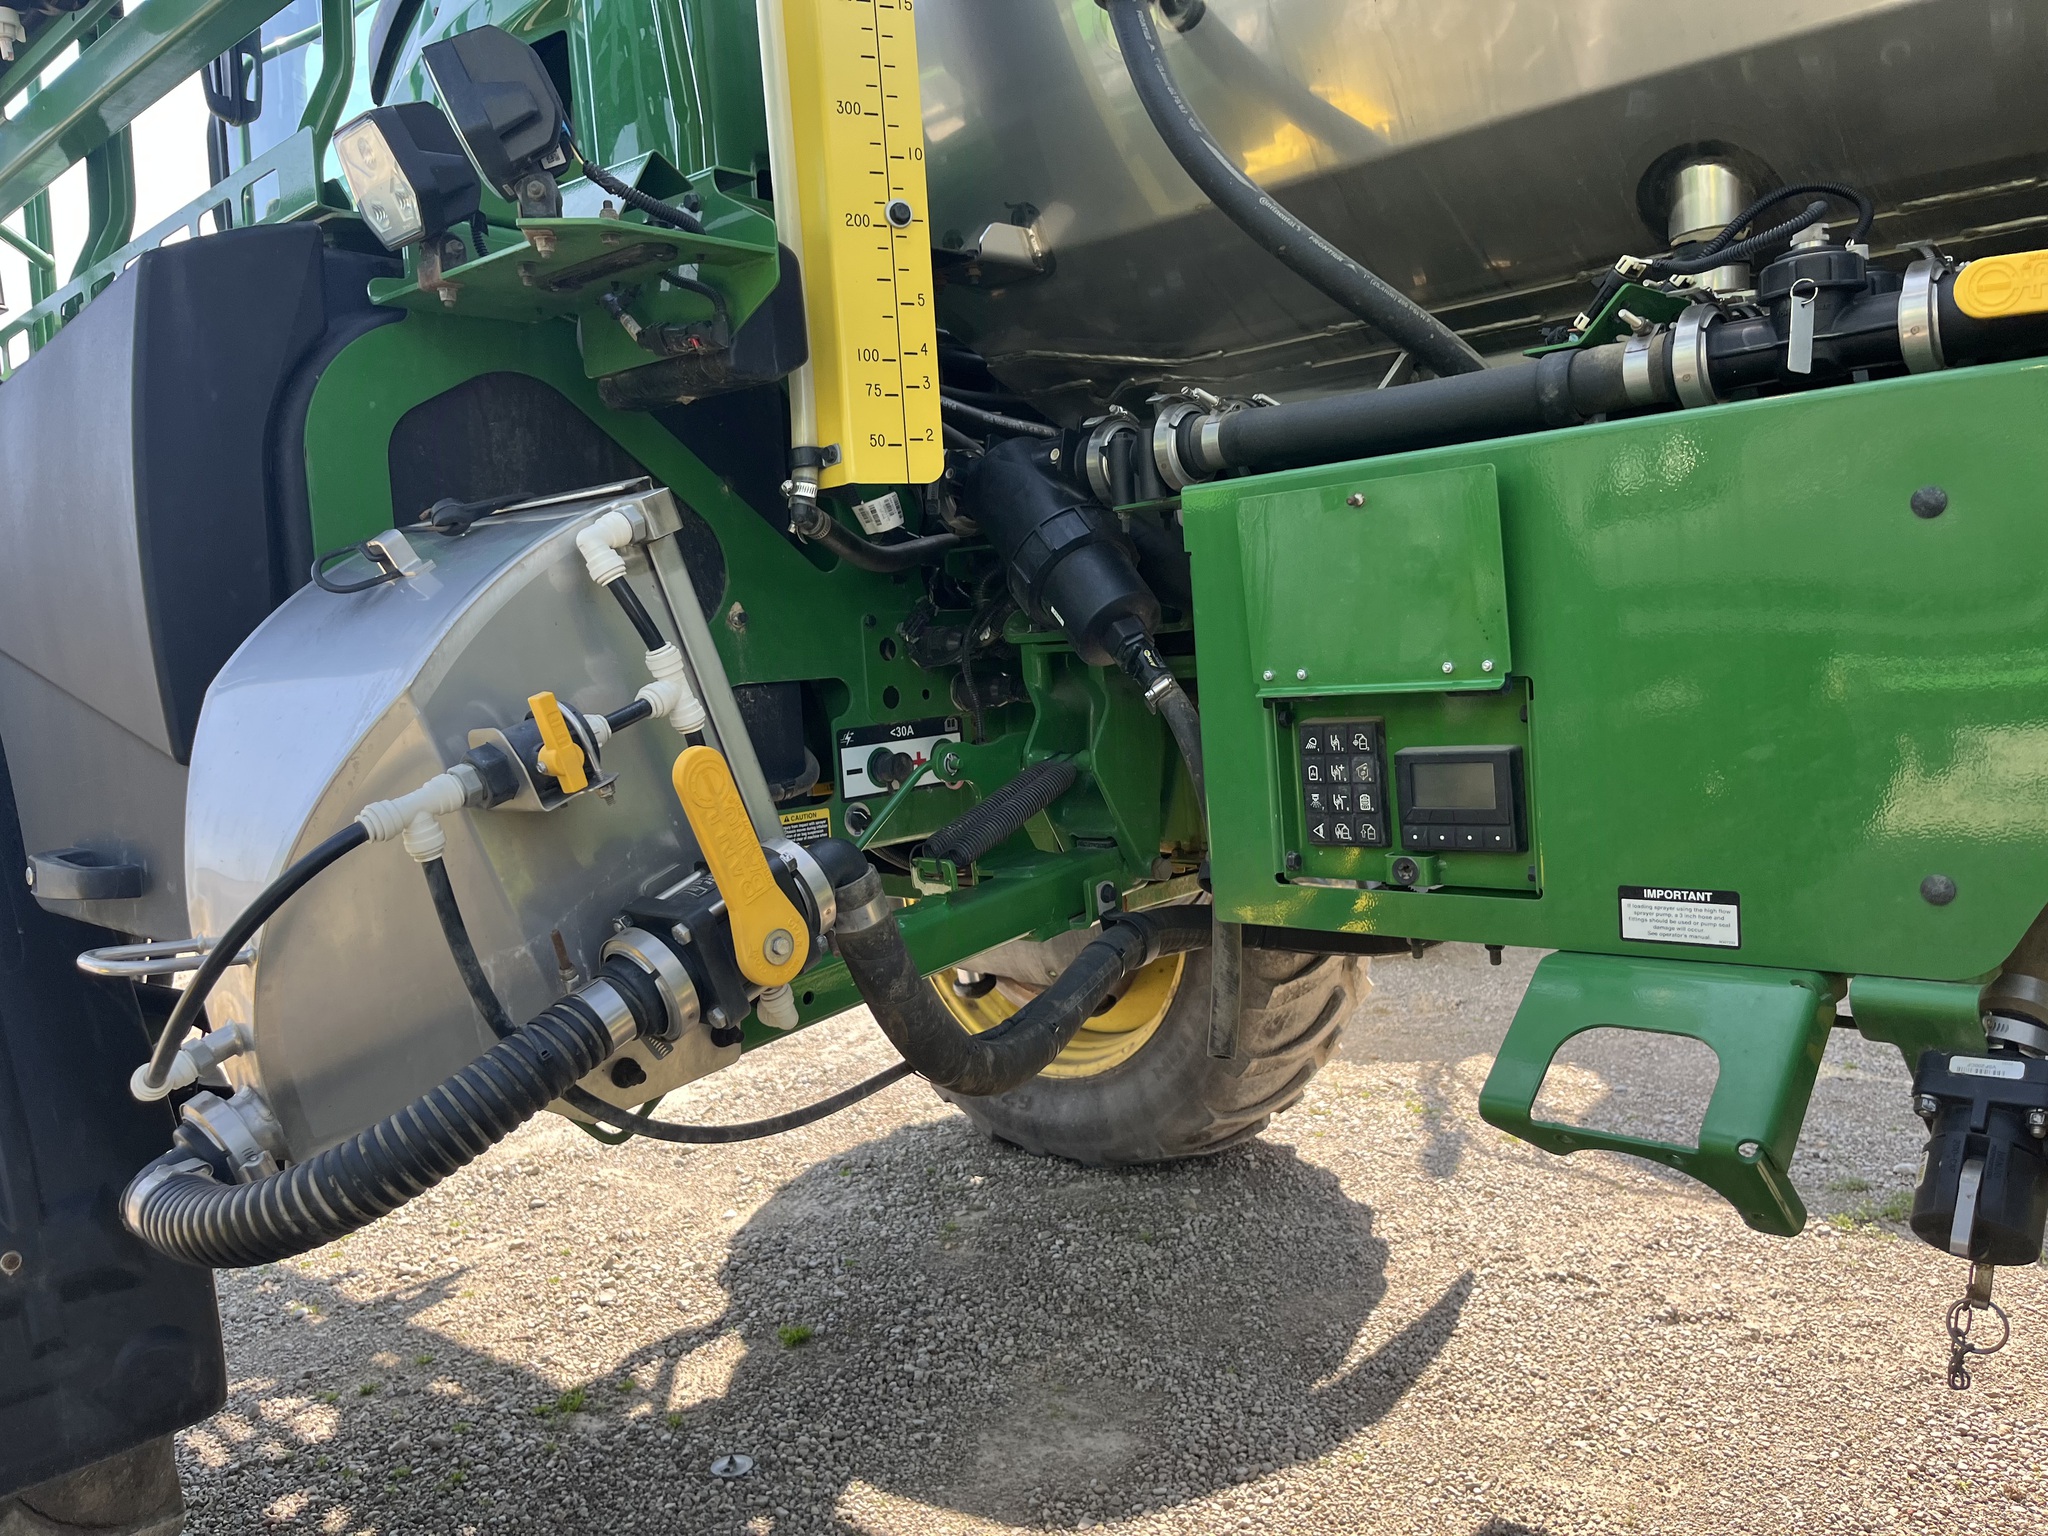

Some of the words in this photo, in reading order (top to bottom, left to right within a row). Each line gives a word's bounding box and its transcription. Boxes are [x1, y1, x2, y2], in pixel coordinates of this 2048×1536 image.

[898, 0, 913, 10] 15
[836, 100, 861, 116] 300
[908, 147, 923, 161] 10
[845, 213, 870, 228] 200
[1259, 197, 1297, 229] Continental
[1309, 235, 1343, 262] FRONTIER
[917, 293, 926, 307] 5
[857, 348, 879, 362] 100
[920, 343, 929, 357] 4
[922, 376, 931, 389] 3
[865, 383, 882, 397] 75
[869, 434, 885, 448] 50
[925, 429, 934, 442] 2
[890, 725, 914, 737] <30A
[790, 812, 817, 821] CAUTION
[1643, 888, 1713, 902] IMPORTANT
[1659, 931, 1687, 939] operator's
